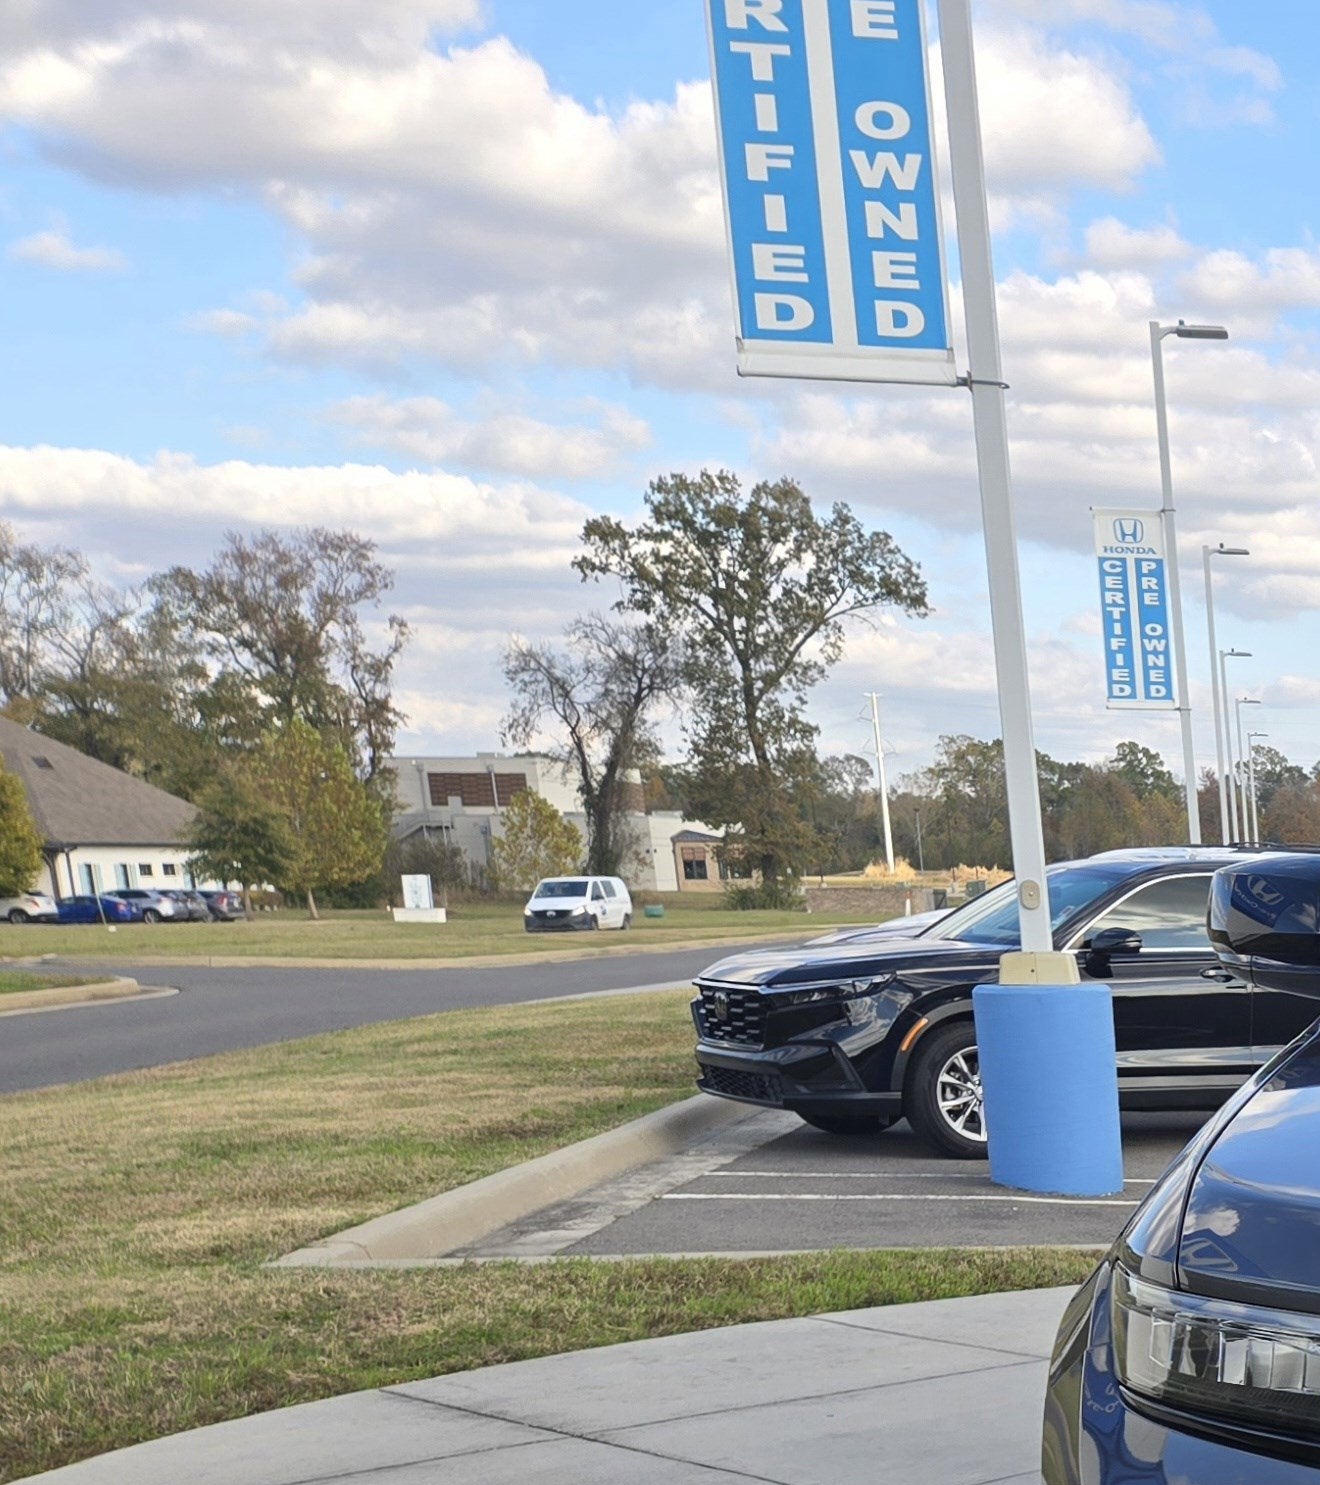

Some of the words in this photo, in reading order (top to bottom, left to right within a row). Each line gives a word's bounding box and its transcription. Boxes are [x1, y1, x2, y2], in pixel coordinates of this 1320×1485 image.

[849, 100, 925, 338] OWNED
[1102, 545, 1157, 555] HONDA
[1141, 561, 1160, 605] PRE
[1102, 560, 1132, 697] CERTIFIED
[1143, 623, 1167, 698] OWNED
